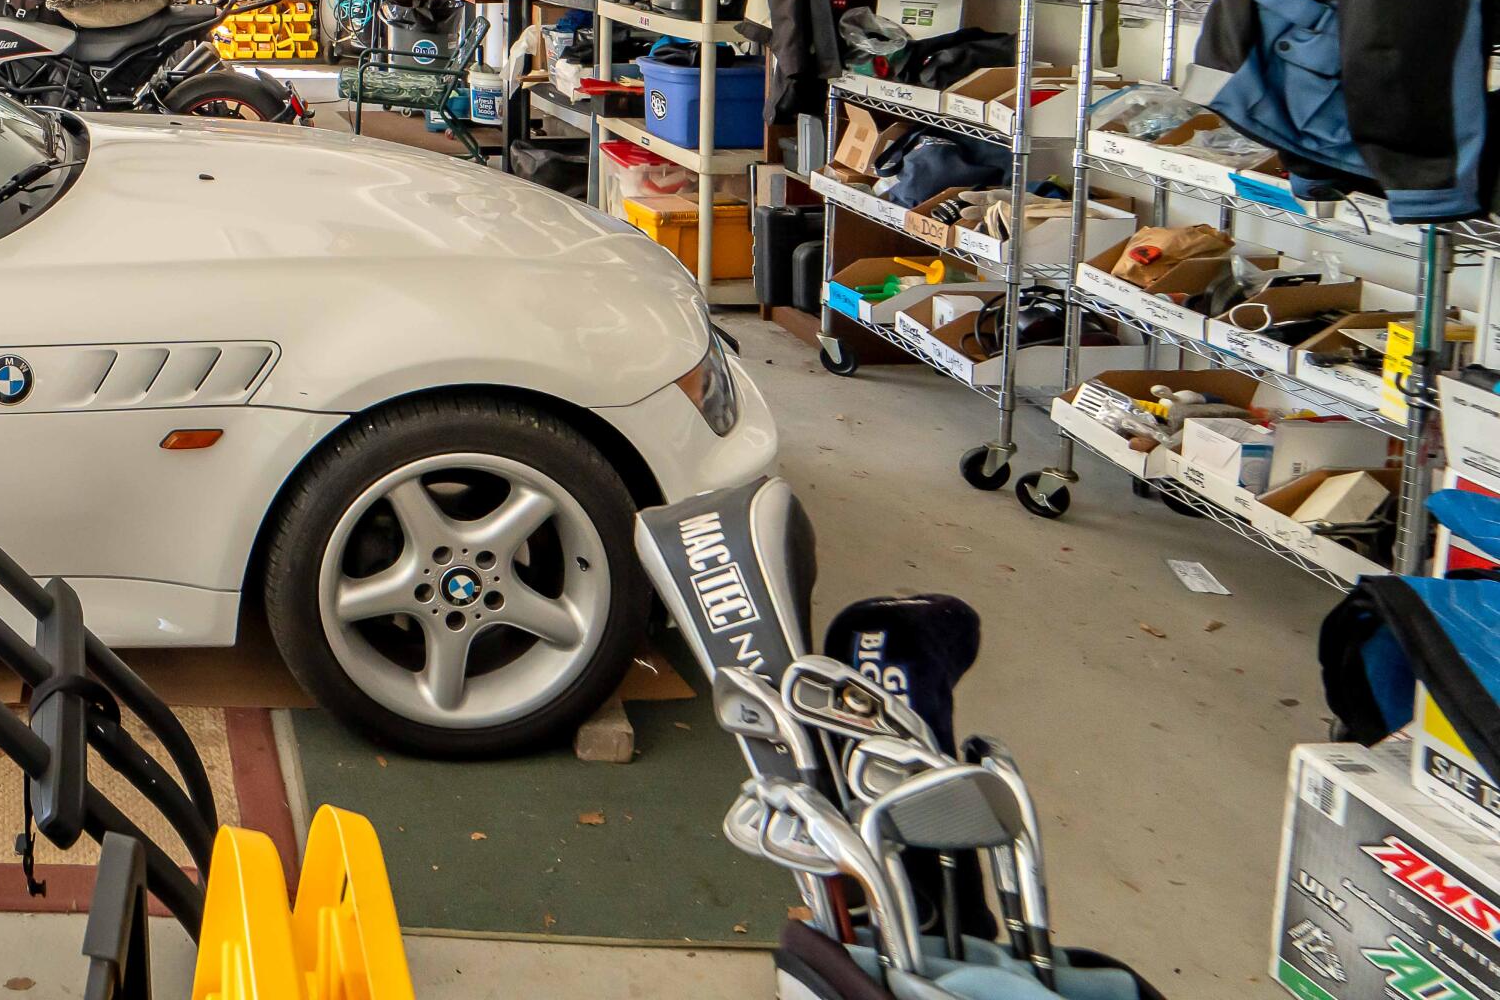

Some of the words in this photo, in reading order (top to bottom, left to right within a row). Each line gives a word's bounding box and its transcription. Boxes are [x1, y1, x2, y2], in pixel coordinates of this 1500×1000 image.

[921, 218, 944, 240] DOG
[1431, 754, 1477, 800] SAE
[1300, 869, 1347, 916] ULV
[1360, 835, 1500, 940] AMS
